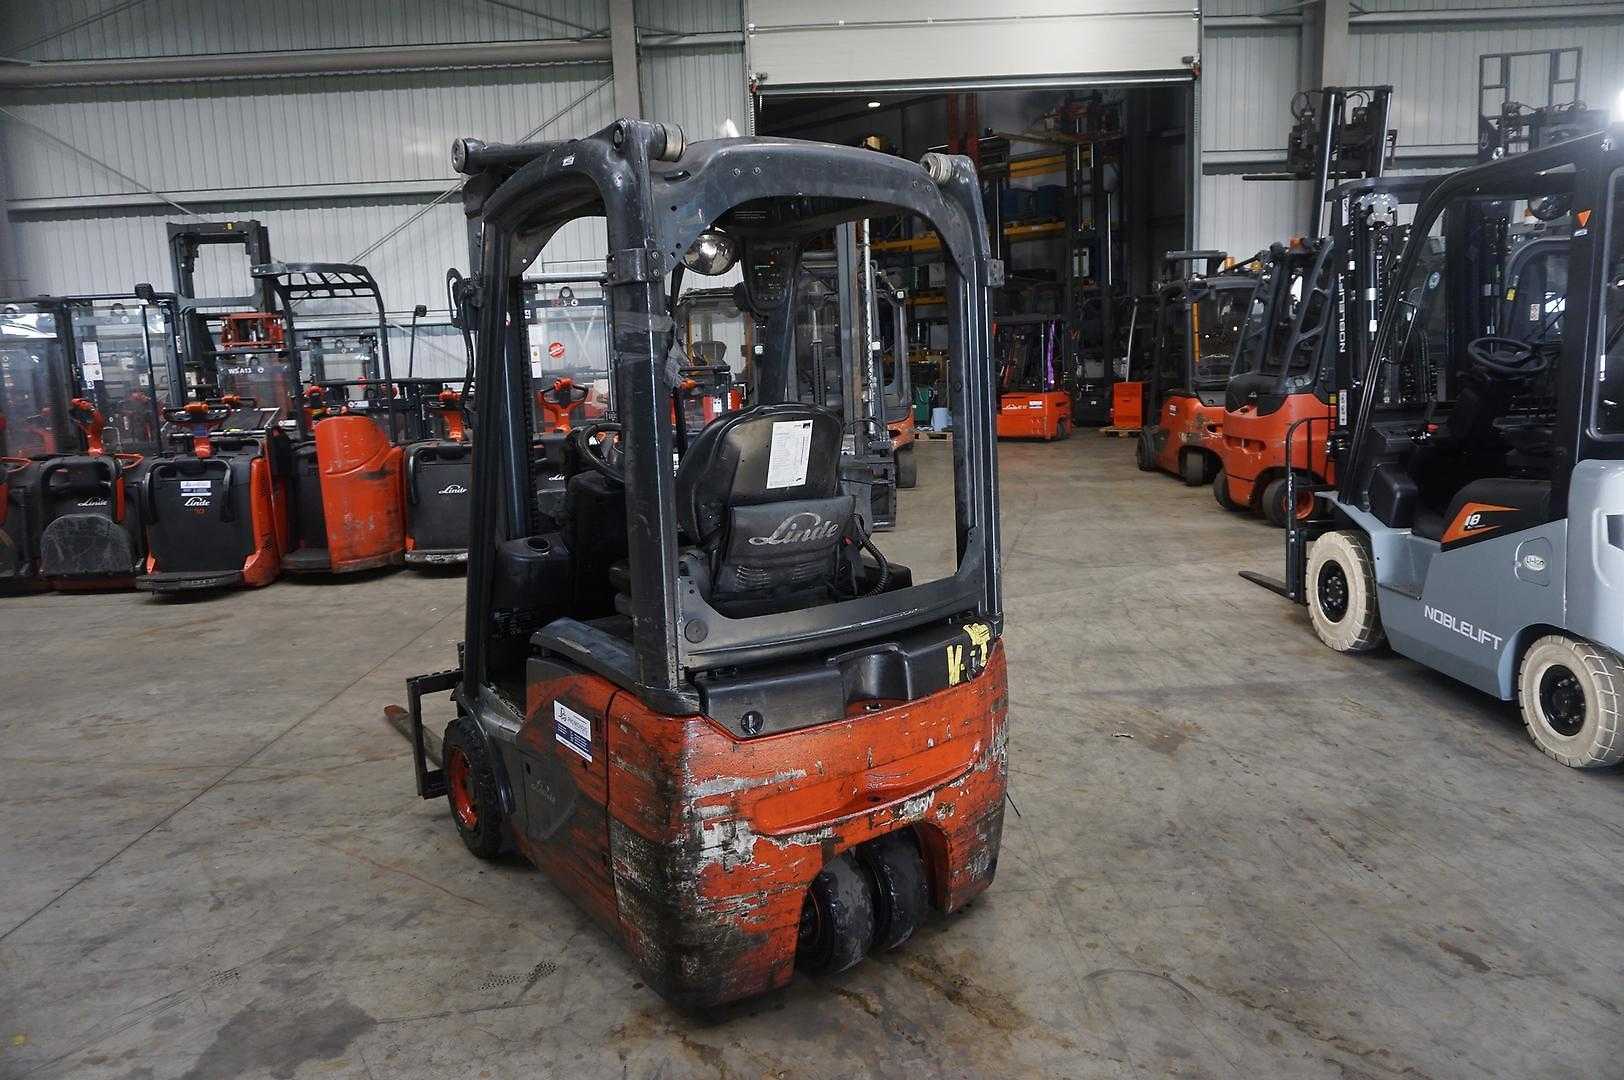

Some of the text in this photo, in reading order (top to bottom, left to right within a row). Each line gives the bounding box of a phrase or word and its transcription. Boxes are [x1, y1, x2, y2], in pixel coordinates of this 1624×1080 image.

[1338, 273, 1346, 353] NOBLELIFT
[184, 497, 211, 507] Linde
[748, 512, 839, 546] Linde
[1464, 513, 1481, 527] 18
[1424, 605, 1503, 651] NOBLELIFT
